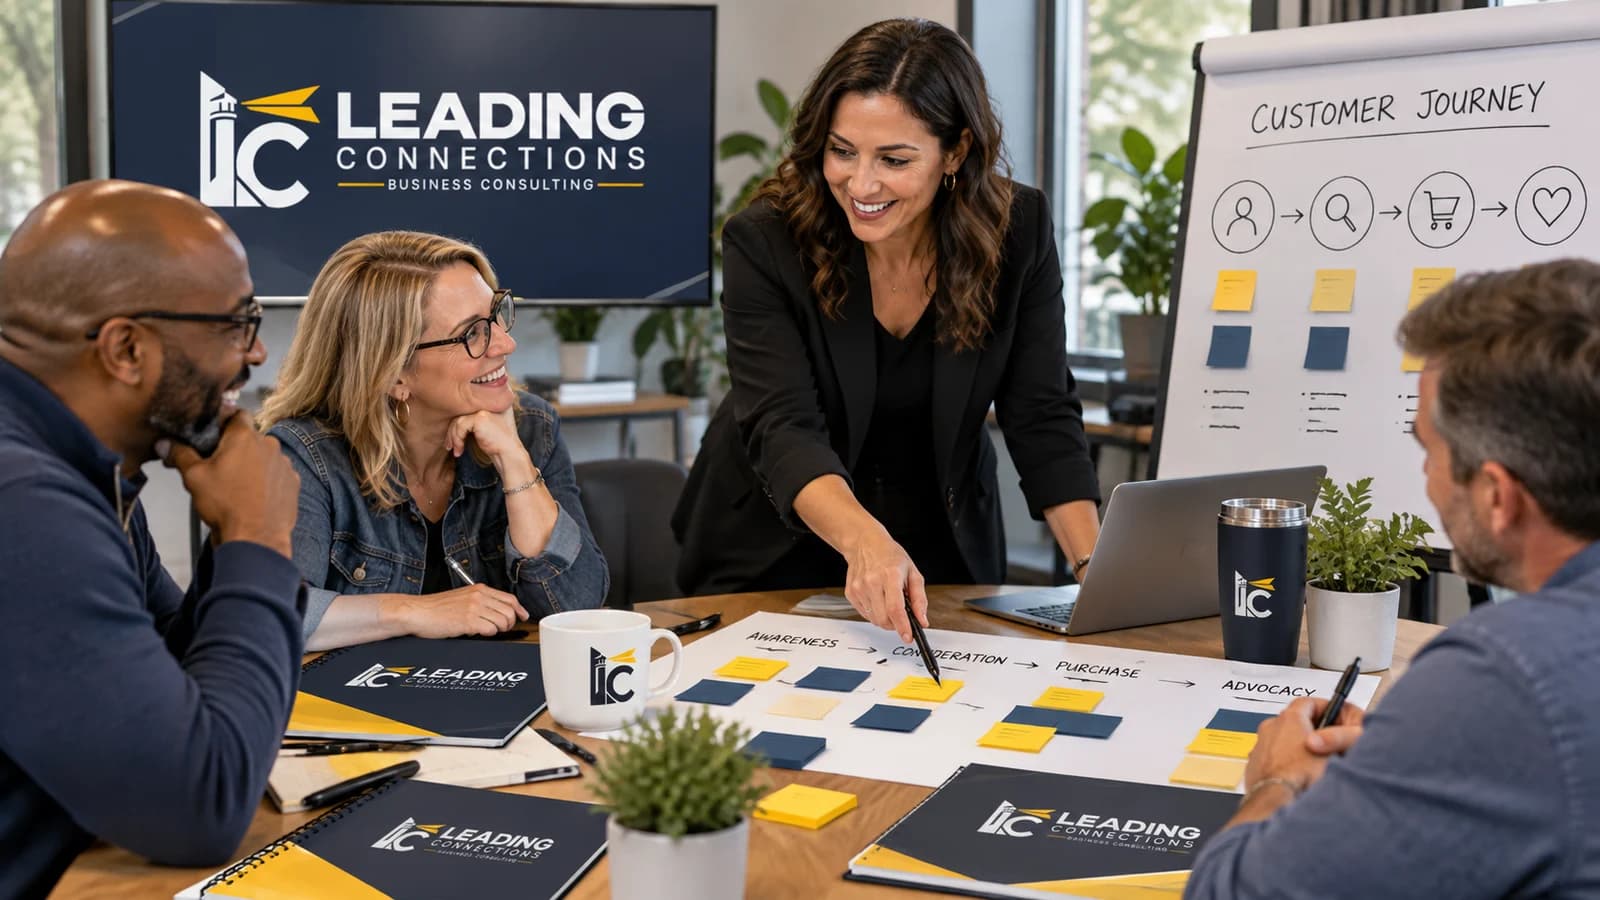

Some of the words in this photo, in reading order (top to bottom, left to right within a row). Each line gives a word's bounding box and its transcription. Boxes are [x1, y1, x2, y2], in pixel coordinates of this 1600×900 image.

[337, 91, 645, 141] LEADING
[1250, 94, 1396, 134] CUSTOMER
[1416, 81, 1546, 120] JOURNEY
[336, 146, 645, 171] CONNECTIONS
[388, 178, 473, 191] BUSINESS
[480, 178, 594, 191] CONSULTING
[412, 667, 528, 682] LEADING
[746, 631, 840, 648] AWARENESS
[892, 646, 1009, 665] CONDERATION
[1055, 660, 1142, 679] PURCHASE
[1221, 679, 1317, 698] ADVOCACY
[405, 677, 520, 688] CONNECTIONS
[1050, 825, 1195, 849] CONNECTIONS
[1055, 811, 1201, 840] LEADING
[430, 839, 543, 859] CONNECTIONS
[439, 826, 555, 851] LEADING
